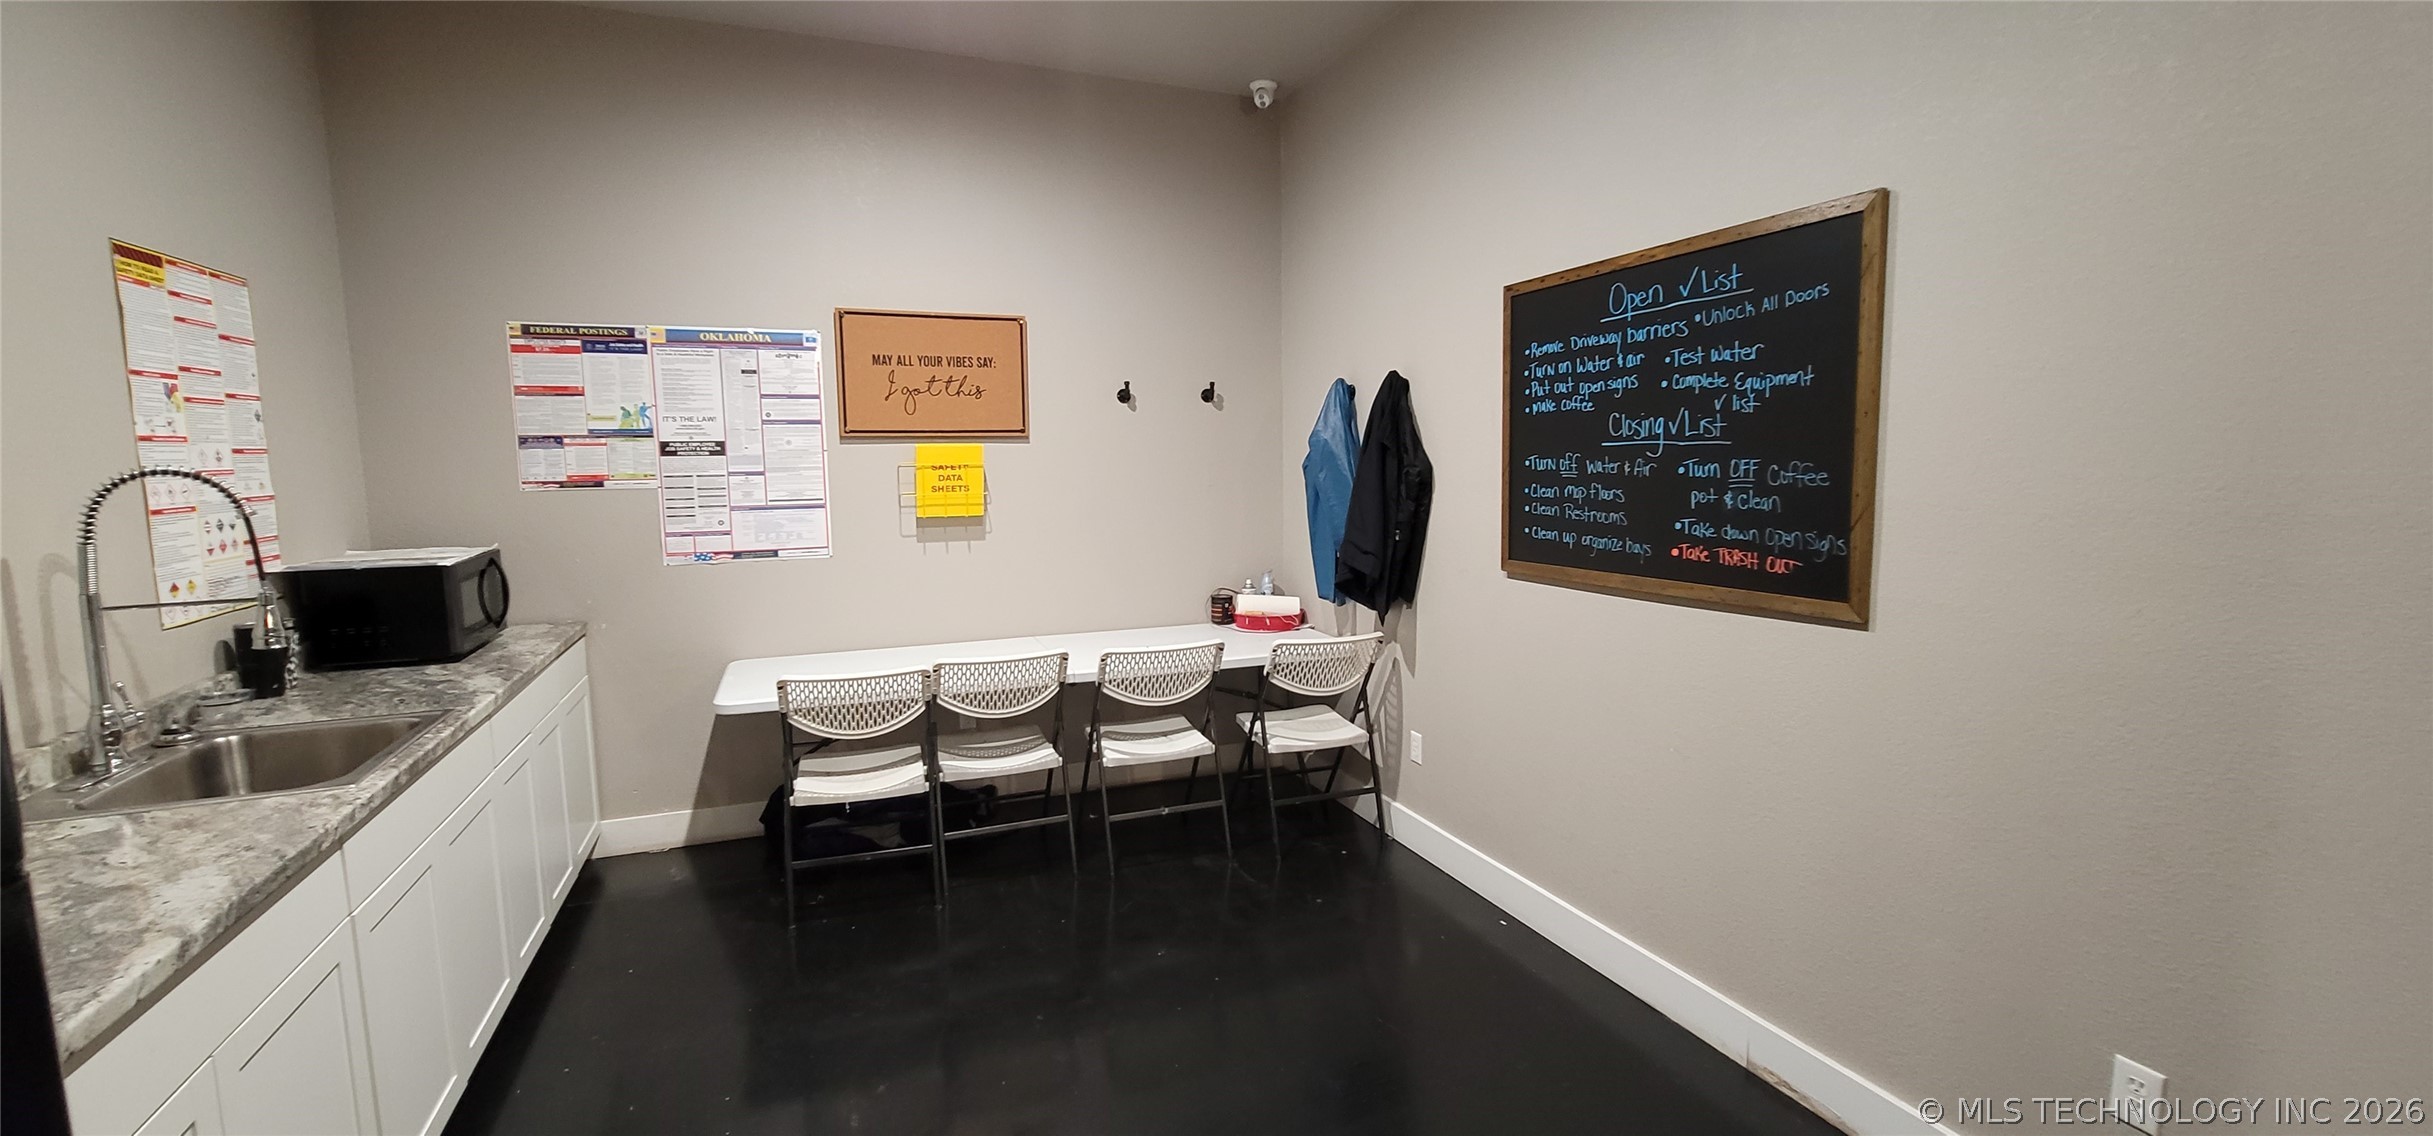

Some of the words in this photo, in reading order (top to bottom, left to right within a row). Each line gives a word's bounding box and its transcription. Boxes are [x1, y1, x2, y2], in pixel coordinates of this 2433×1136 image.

[1609, 282, 1664, 321] Open
[1701, 263, 1744, 294] List
[1702, 301, 1755, 327] Unlock
[1761, 294, 1778, 313] All
[1785, 282, 1830, 308] Doors
[529, 325, 577, 335] FEDERAL
[579, 327, 629, 336] POSTINGS
[700, 332, 772, 343] OKLAHOMA
[1530, 340, 1566, 359] Remove
[1570, 331, 1622, 355] Driveway
[1627, 319, 1689, 344] barriers
[872, 354, 893, 366] MAY
[897, 355, 914, 366] ALL
[917, 355, 943, 367] YOUR
[946, 356, 973, 368] VIBES
[976, 357, 996, 368] SAY:
[1558, 361, 1572, 374] on
[1626, 352, 1645, 368] air
[1670, 345, 1706, 368] Test
[884, 369, 898, 401] I
[901, 374, 943, 415] got
[943, 374, 987, 400] this
[1531, 381, 1551, 398] Put
[1554, 376, 1575, 394] out
[1579, 380, 1605, 401] open
[1607, 374, 1639, 398] signs
[1672, 372, 1729, 394] Complete
[1734, 364, 1815, 398] Equipment
[1732, 393, 1761, 413] list
[1608, 412, 1665, 458] Closing
[1684, 410, 1728, 438] List
[938, 474, 963, 482] DATA
[1634, 459, 1657, 477] Air
[1683, 458, 1721, 478] Turn
[1730, 459, 1761, 478] OFF
[1767, 460, 1830, 487] Coffee
[931, 485, 970, 493] SHEETS
[1530, 483, 1559, 498] Clean
[1564, 485, 1587, 504] mop
[1589, 482, 1625, 503] floors
[1690, 488, 1718, 509] pot
[1531, 502, 1559, 517] Clean
[1563, 503, 1628, 526] Restrooms
[1531, 526, 1559, 541] Clean
[1562, 531, 1577, 549] up
[1581, 535, 1623, 557] organize
[1679, 518, 1717, 538] Take
[1721, 524, 1759, 544] down
[1712, 547, 1760, 570] TRASH
[1765, 556, 1803, 574] OUT
